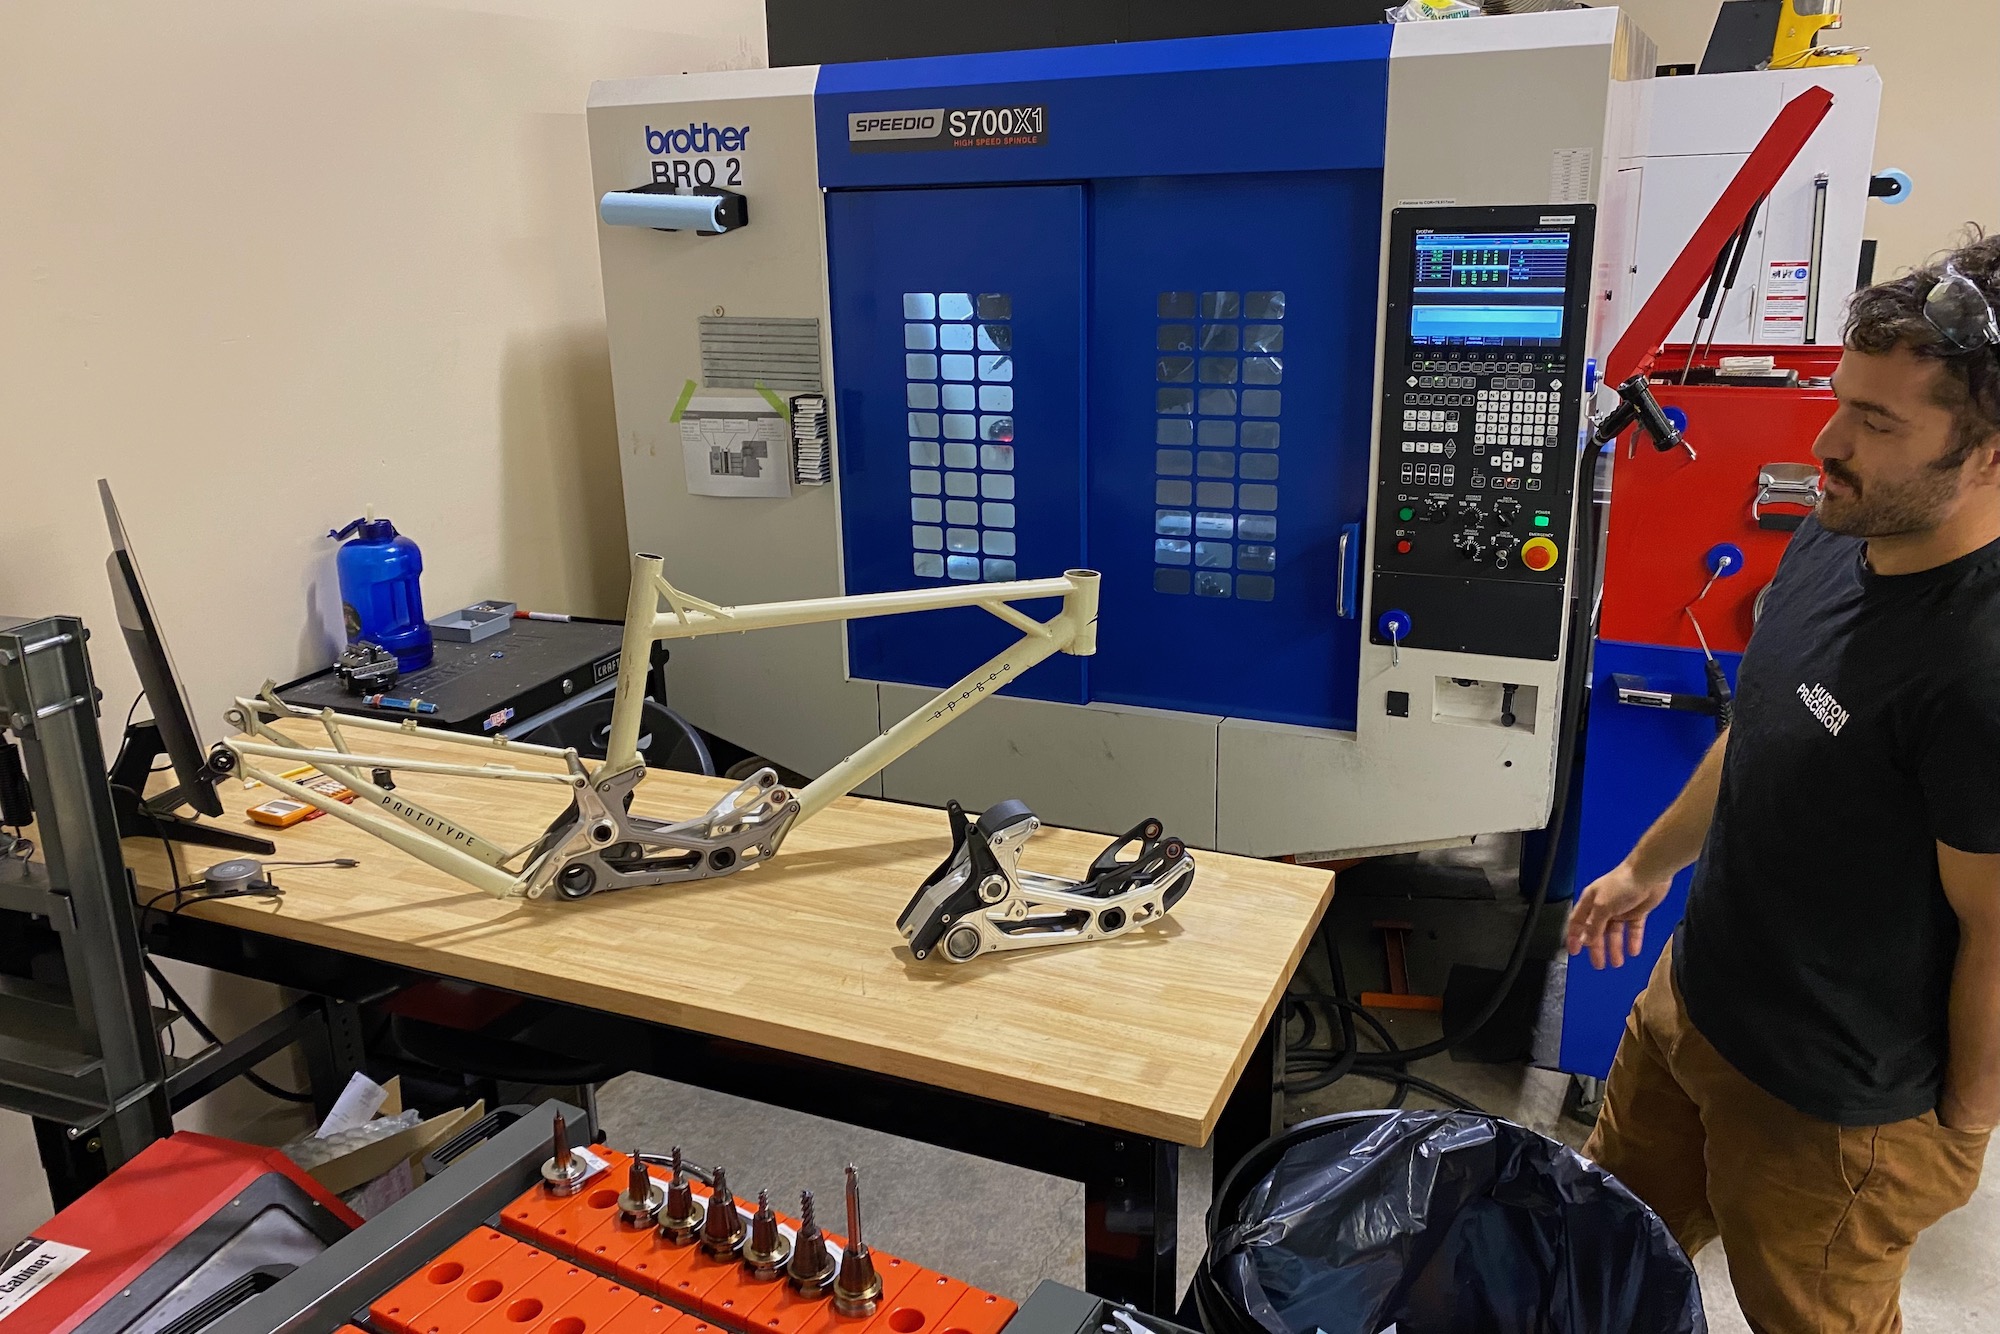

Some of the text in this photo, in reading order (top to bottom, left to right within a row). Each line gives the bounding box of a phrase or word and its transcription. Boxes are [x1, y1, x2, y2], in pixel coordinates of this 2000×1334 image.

[645, 122, 750, 155] brother
[855, 107, 1043, 137] SPEEDIO S700X1
[953, 136, 1038, 147] HIGH SPEED SPINDLE
[651, 157, 742, 188] BRO 2
[1796, 682, 1843, 737] PRECISION
[1811, 682, 1851, 726] HUSTON
[381, 796, 476, 847] PROTOTYPE
[0, 1253, 58, 1294] Cabinet
